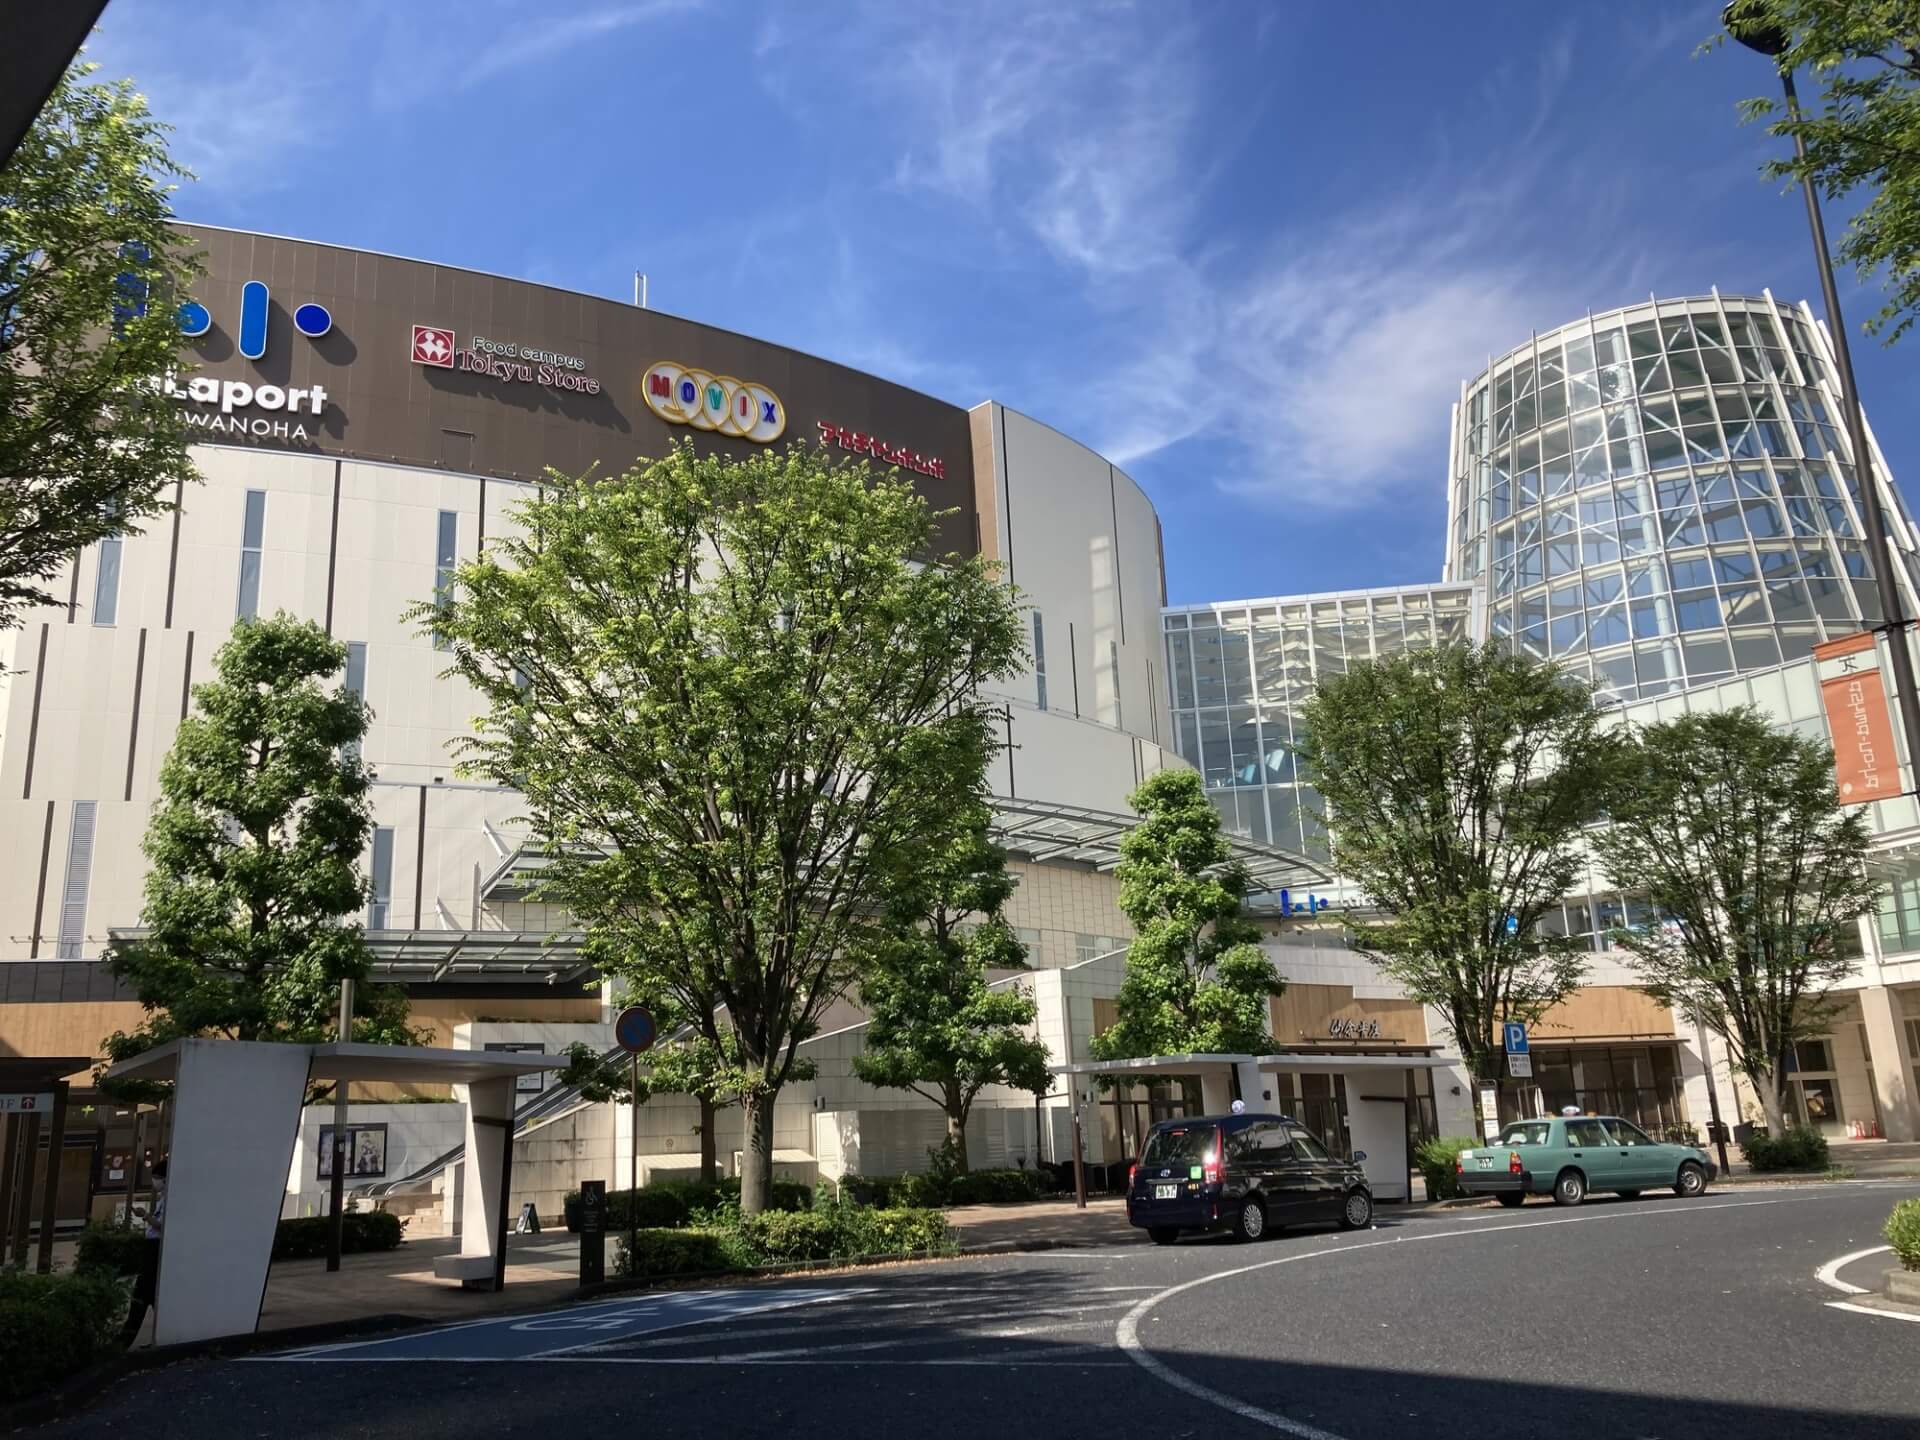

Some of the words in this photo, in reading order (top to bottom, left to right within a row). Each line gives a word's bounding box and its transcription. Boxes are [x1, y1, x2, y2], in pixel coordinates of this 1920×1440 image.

[456, 349, 533, 382] Tokyu
[538, 364, 601, 394] Store
[473, 336, 518, 357] Food
[520, 346, 585, 371] campus
[650, 373, 777, 424] MOVIX
[1510, 1026, 1523, 1050] P
